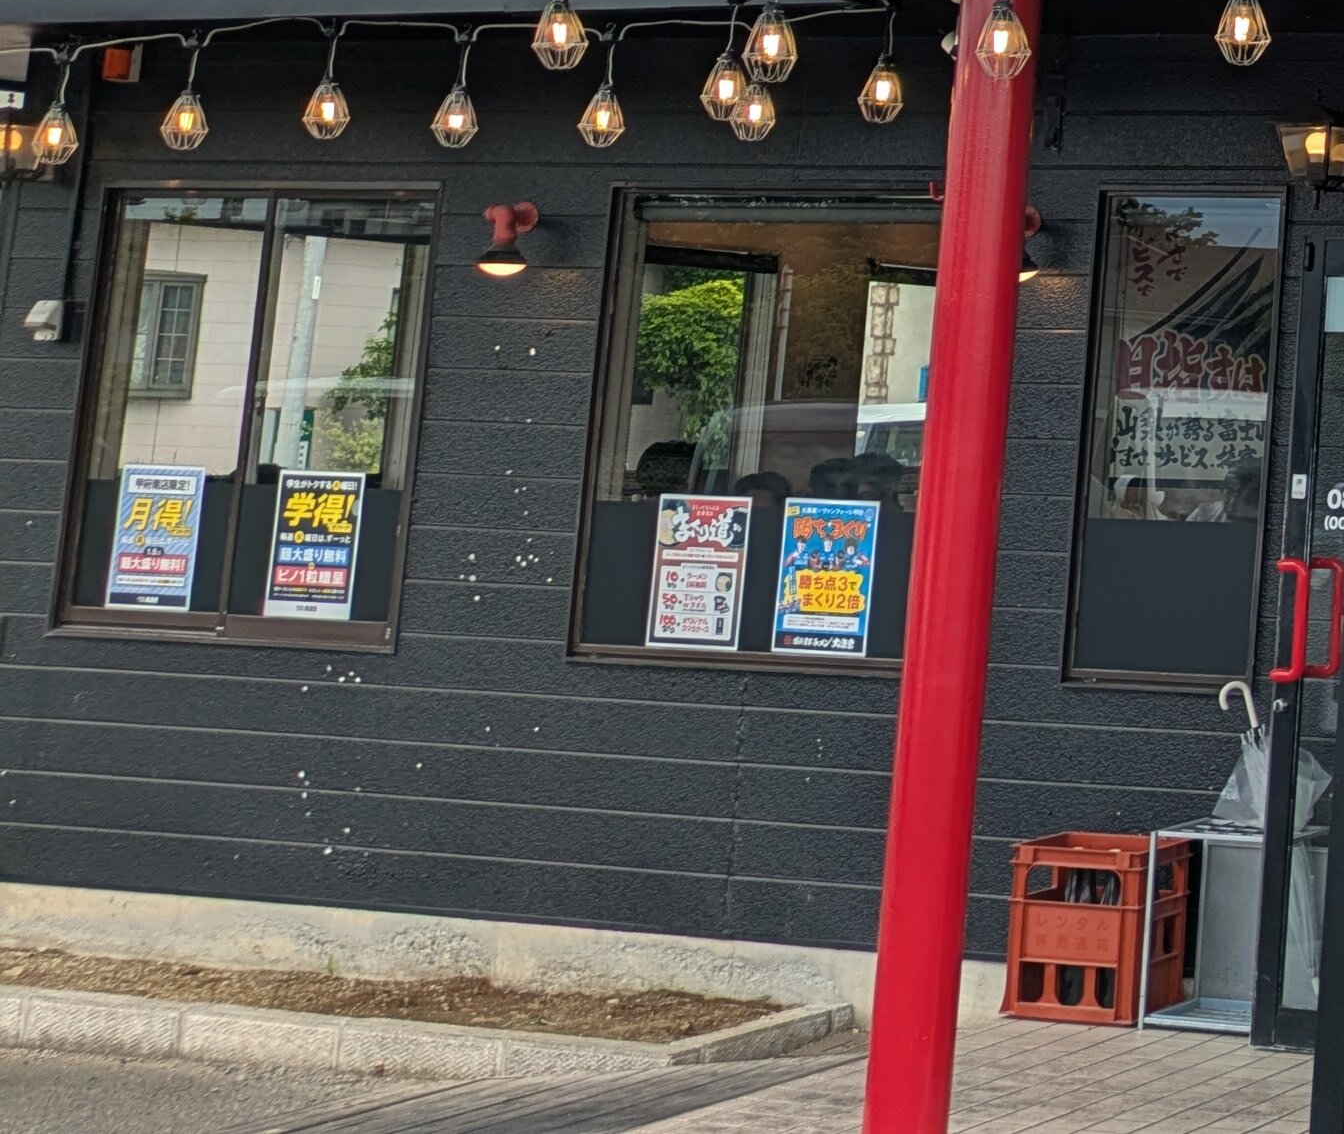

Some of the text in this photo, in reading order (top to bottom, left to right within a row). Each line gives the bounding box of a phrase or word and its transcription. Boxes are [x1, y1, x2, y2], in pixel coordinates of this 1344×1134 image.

[123, 498, 194, 531] 月得!
[283, 493, 356, 528] 学得!
[279, 547, 347, 563] 超大盛り無料
[687, 572, 708, 580] ラーメン
[798, 574, 857, 592] 勝ち点3で
[802, 593, 861, 610] まくり2倍
[1036, 914, 1109, 931] レンタル
